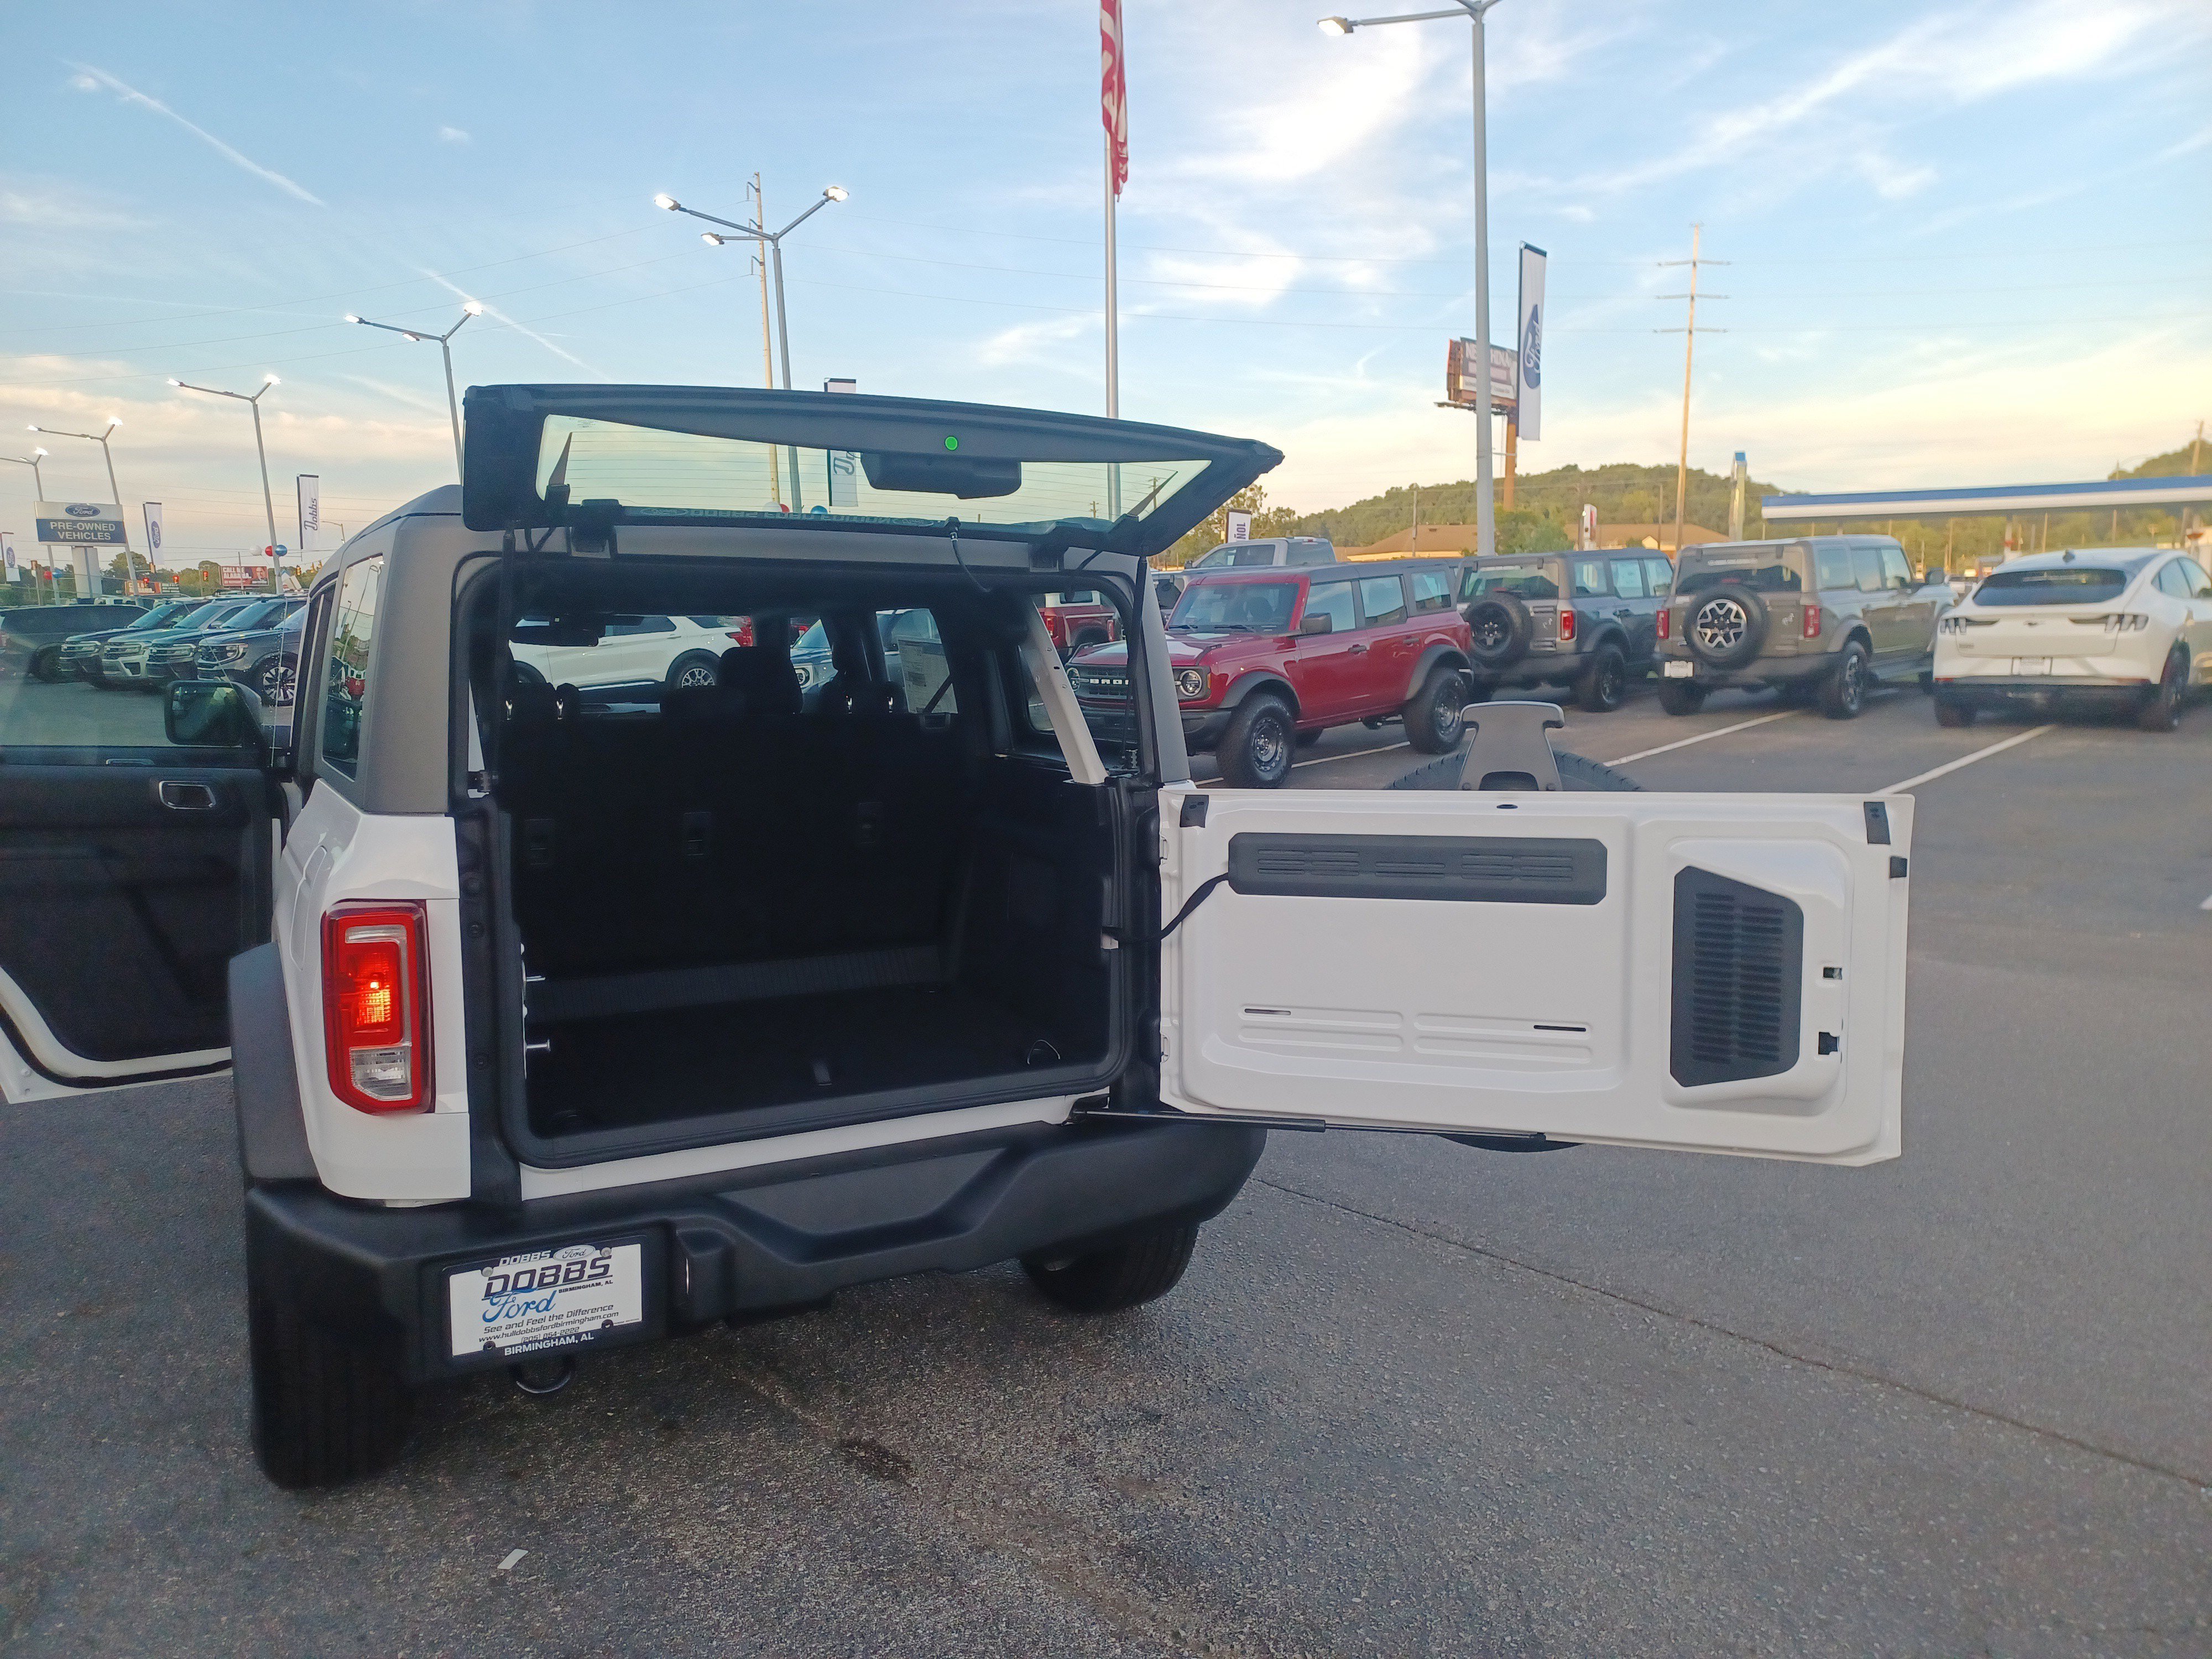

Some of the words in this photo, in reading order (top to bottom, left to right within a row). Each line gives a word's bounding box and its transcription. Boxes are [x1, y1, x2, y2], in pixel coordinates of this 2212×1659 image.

[50, 521, 115, 531] PRE-OWNED
[304, 498, 318, 531] Dobbs
[58, 531, 111, 540] VEHICLES
[1234, 523, 1246, 539] ÑOL
[499, 1250, 551, 1267] DOBBS
[484, 1255, 612, 1298] DOBBS
[559, 1282, 603, 1293] BIRMINGHAM,
[482, 1288, 557, 1323] Ford
[479, 1312, 619, 1342] www.hulldobbsfordbirmingham.com
[484, 1326, 503, 1334] See
[505, 1320, 524, 1330] and
[526, 1316, 546, 1326] Feel
[566, 1305, 614, 1318] Difference
[504, 1335, 578, 1356] BIRMINGHAM,
[581, 1333, 594, 1342] AL
